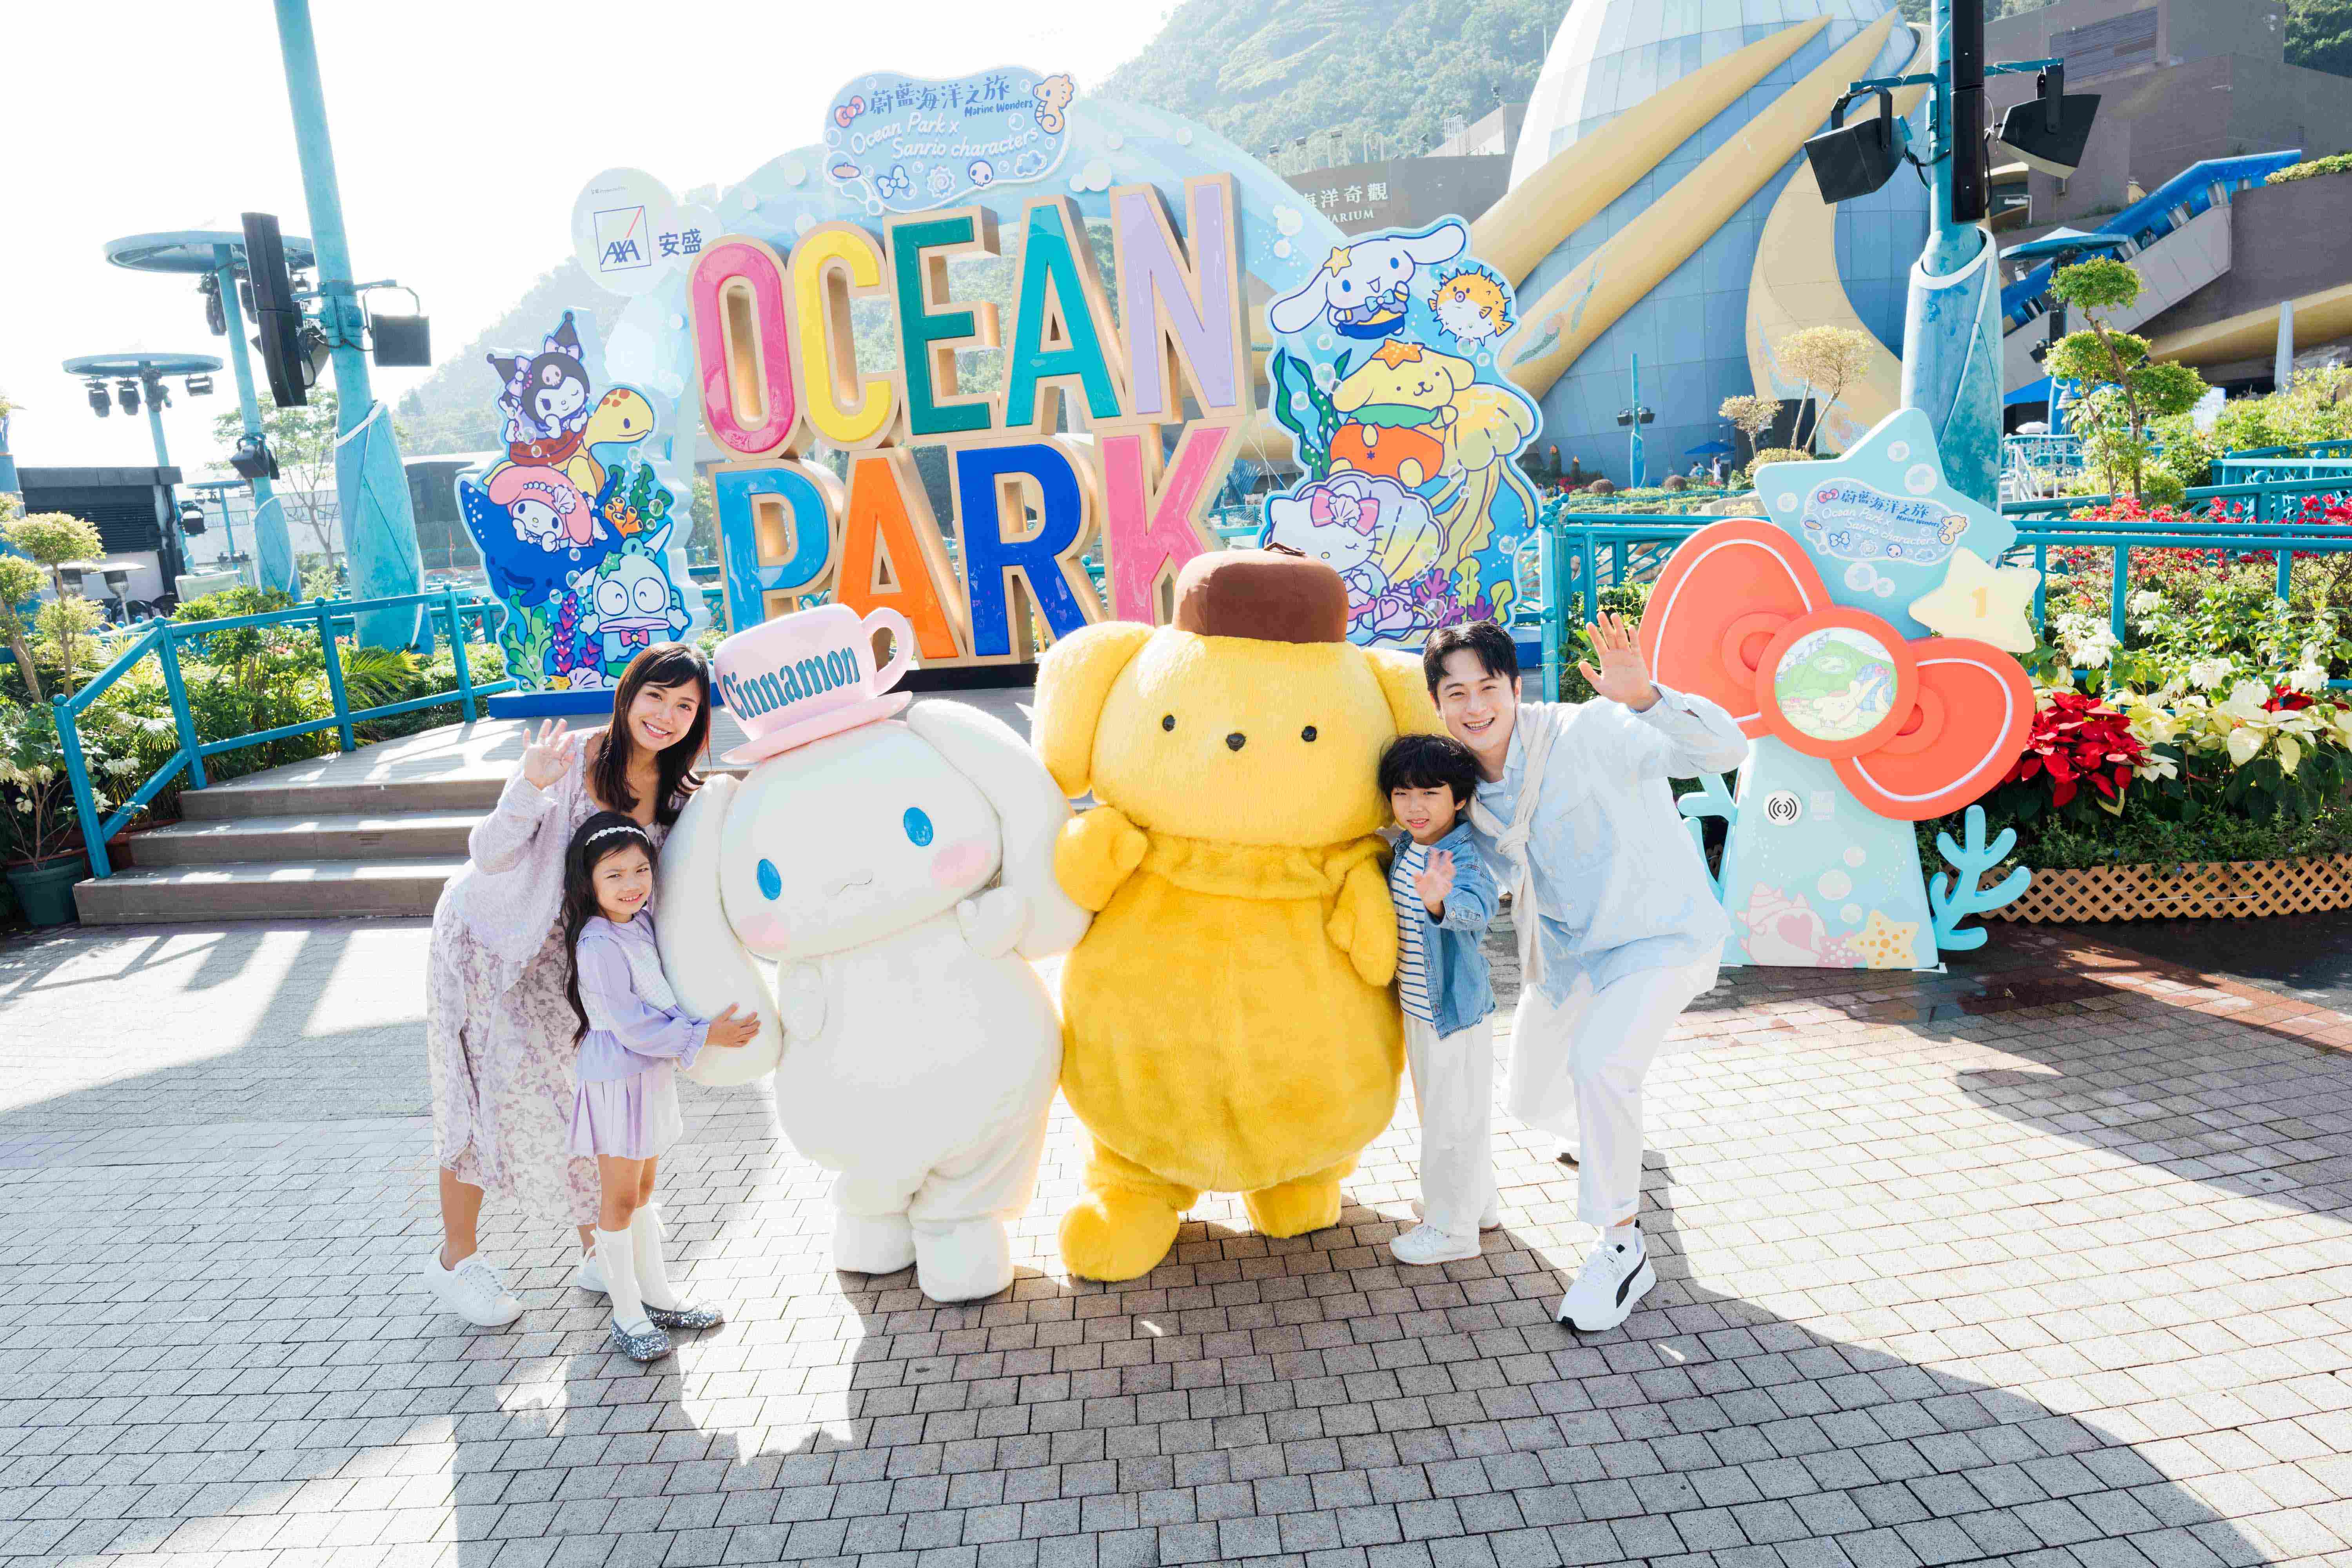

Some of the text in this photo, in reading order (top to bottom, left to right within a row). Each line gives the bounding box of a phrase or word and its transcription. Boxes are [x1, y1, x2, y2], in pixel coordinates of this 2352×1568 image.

[869, 75, 1010, 114] 蔚藍海洋之旅
[964, 99, 1034, 118] Marine Wonders
[852, 123, 902, 154] Ocean
[907, 111, 946, 135] Park
[891, 126, 1039, 160] Sanrio characters
[601, 228, 702, 265] AXA 安盛
[687, 172, 1250, 461] OCEAN
[1821, 508, 1856, 519] Ocean
[1859, 508, 1884, 524] Park
[1840, 490, 1930, 519] 蔚藍海洋之旅
[1896, 515, 1940, 528] Marine Wonders
[707, 416, 1250, 669] PARK
[1845, 517, 1937, 546] Sanrio characters
[1970, 586, 1989, 618] 1
[723, 647, 860, 720] Cinnamon
